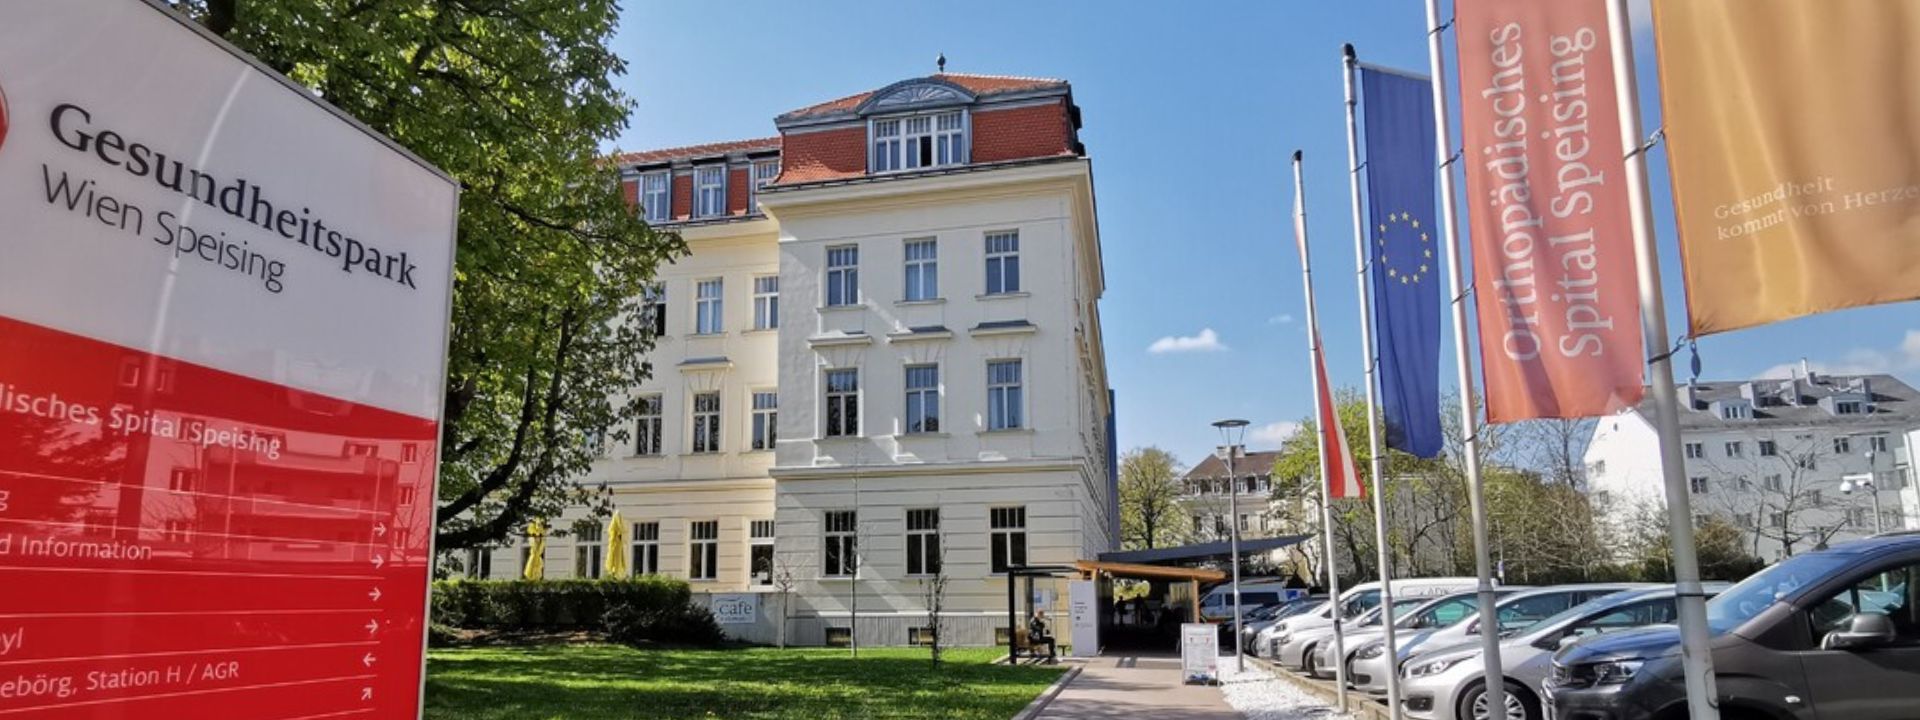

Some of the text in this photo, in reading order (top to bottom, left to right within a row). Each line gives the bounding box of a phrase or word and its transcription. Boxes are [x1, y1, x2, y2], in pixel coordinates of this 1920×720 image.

[50, 103, 417, 289] Gesundheitspark
[1482, 22, 1543, 361] Orthopädisches
[1539, 27, 1613, 358] Spital Speising
[1714, 176, 1834, 219] Gesundheit
[42, 163, 286, 293] Wien Speising
[1717, 209, 1785, 240] kommt
[1791, 200, 1835, 218] von
[108, 405, 182, 438] Spital
[190, 421, 281, 460] Speising
[20, 535, 152, 560] Information
[0, 661, 239, 698] ebörg, Station H / AGR
